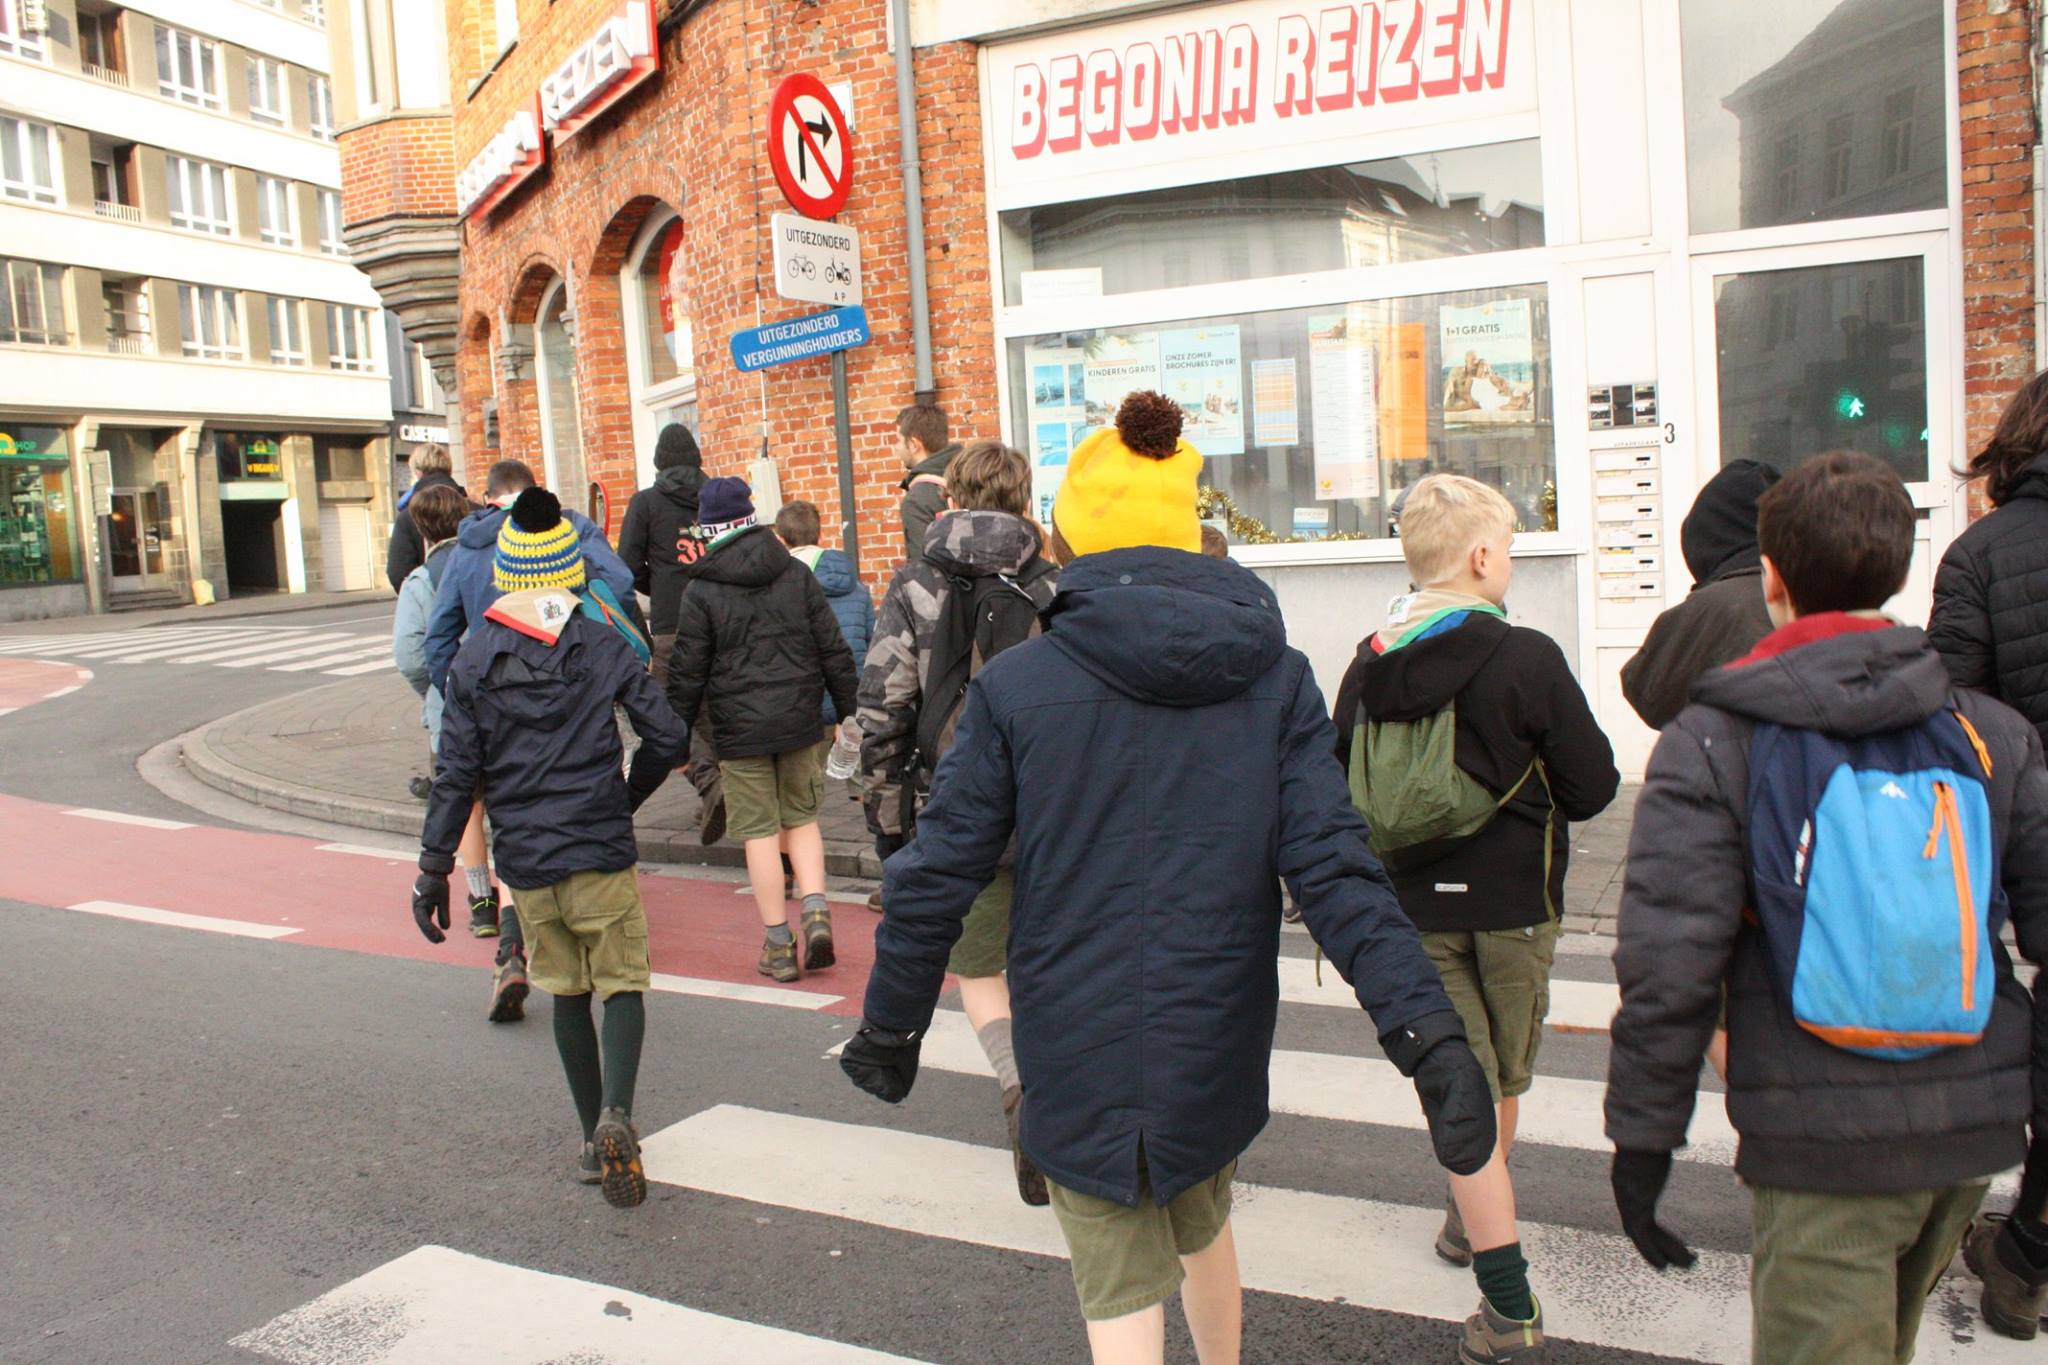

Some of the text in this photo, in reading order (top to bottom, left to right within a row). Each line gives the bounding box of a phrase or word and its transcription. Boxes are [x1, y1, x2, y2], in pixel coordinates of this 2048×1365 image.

[1011, 0, 1512, 160] BEGONIA REIZEN
[785, 227, 851, 253] UITGEZONDERD
[758, 313, 839, 345] UITGEZONDERD
[1462, 323, 1501, 336] GRATIS
[743, 327, 863, 369] VERGUNNINGHOUDERS
[1187, 351, 1212, 360] ZOMER
[1087, 364, 1157, 378] KINDEREN GRATIS
[1166, 359, 1209, 370] BROCHURES
[1664, 422, 1675, 444] 3
